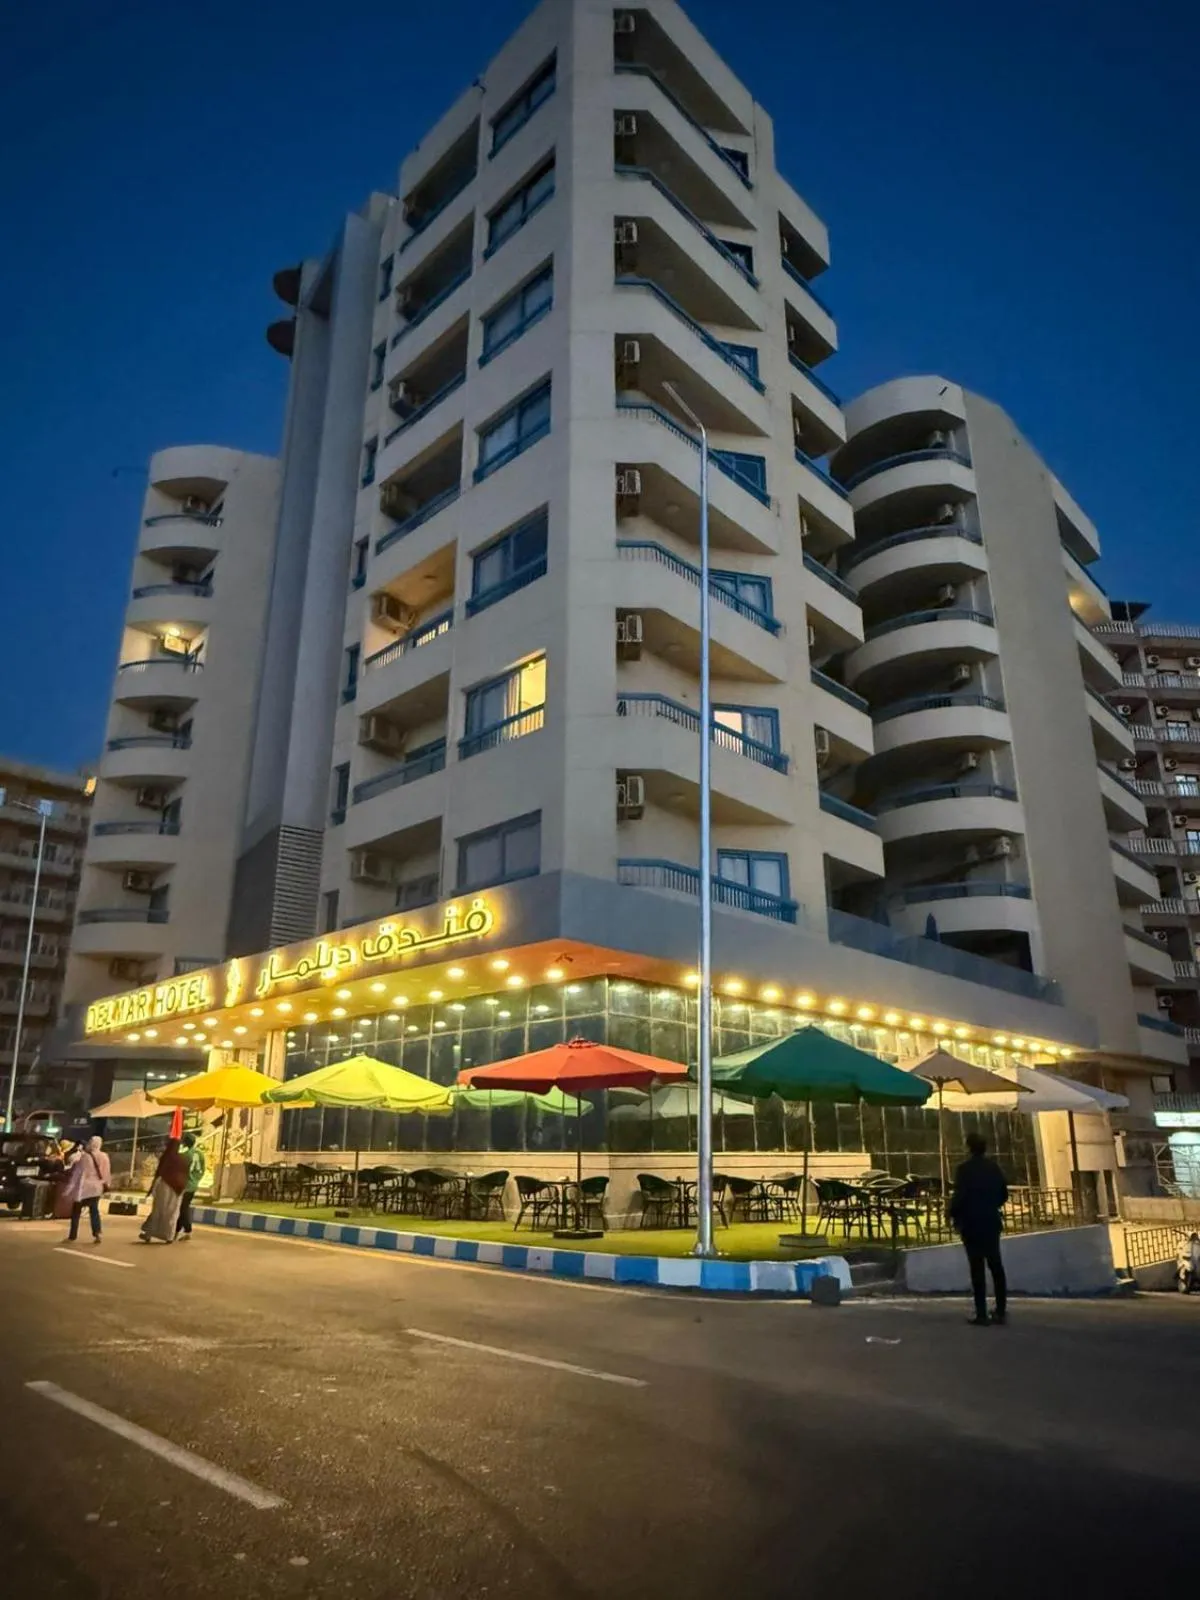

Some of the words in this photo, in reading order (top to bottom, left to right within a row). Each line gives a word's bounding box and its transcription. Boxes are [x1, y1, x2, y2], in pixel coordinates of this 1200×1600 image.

[362, 897, 493, 962] فندق
[256, 941, 357, 997] ديلمار
[86, 991, 150, 1033] DELMAR
[155, 974, 211, 1016] HOTEL
